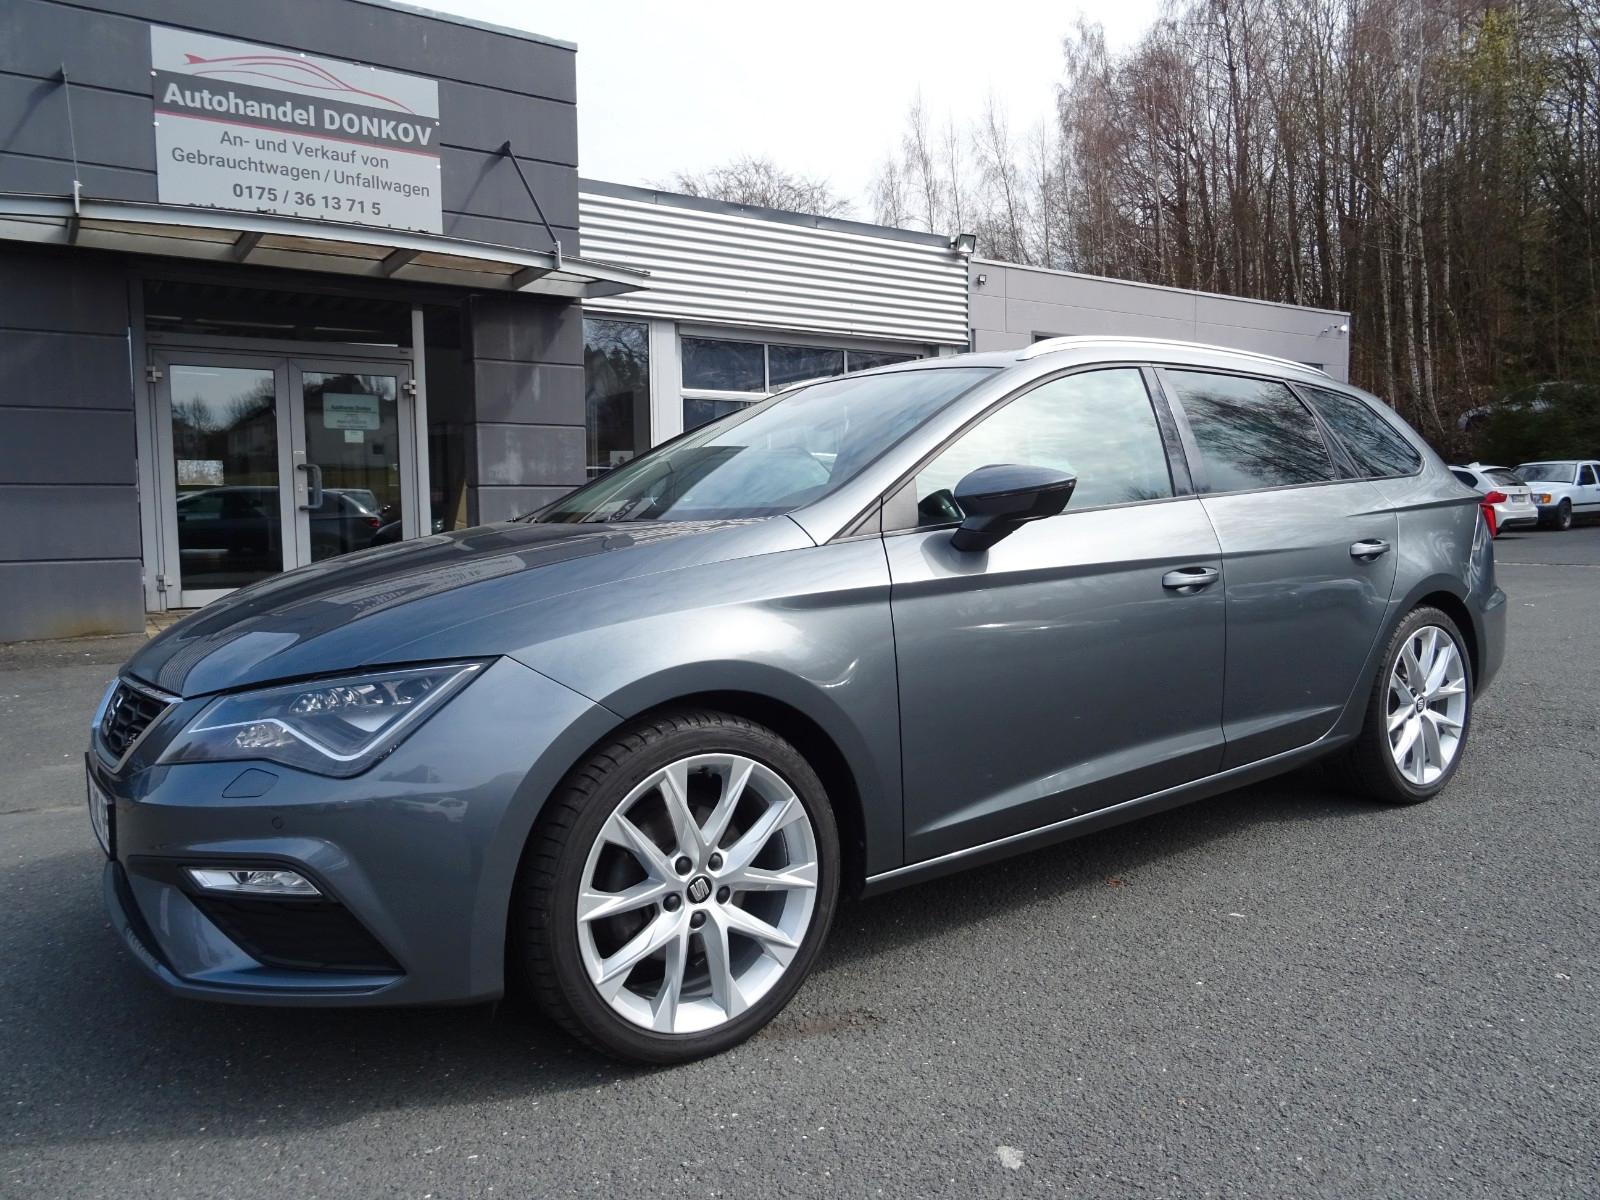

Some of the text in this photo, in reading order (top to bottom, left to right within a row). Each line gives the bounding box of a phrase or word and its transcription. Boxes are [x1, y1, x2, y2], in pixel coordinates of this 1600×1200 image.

[163, 82, 432, 146] Autohandel DONKOV
[172, 147, 320, 181] Gebrauchtwagen
[334, 169, 430, 198] Unfallwagen
[220, 131, 389, 170] An- und Verkauf von
[232, 183, 278, 202] 0175
